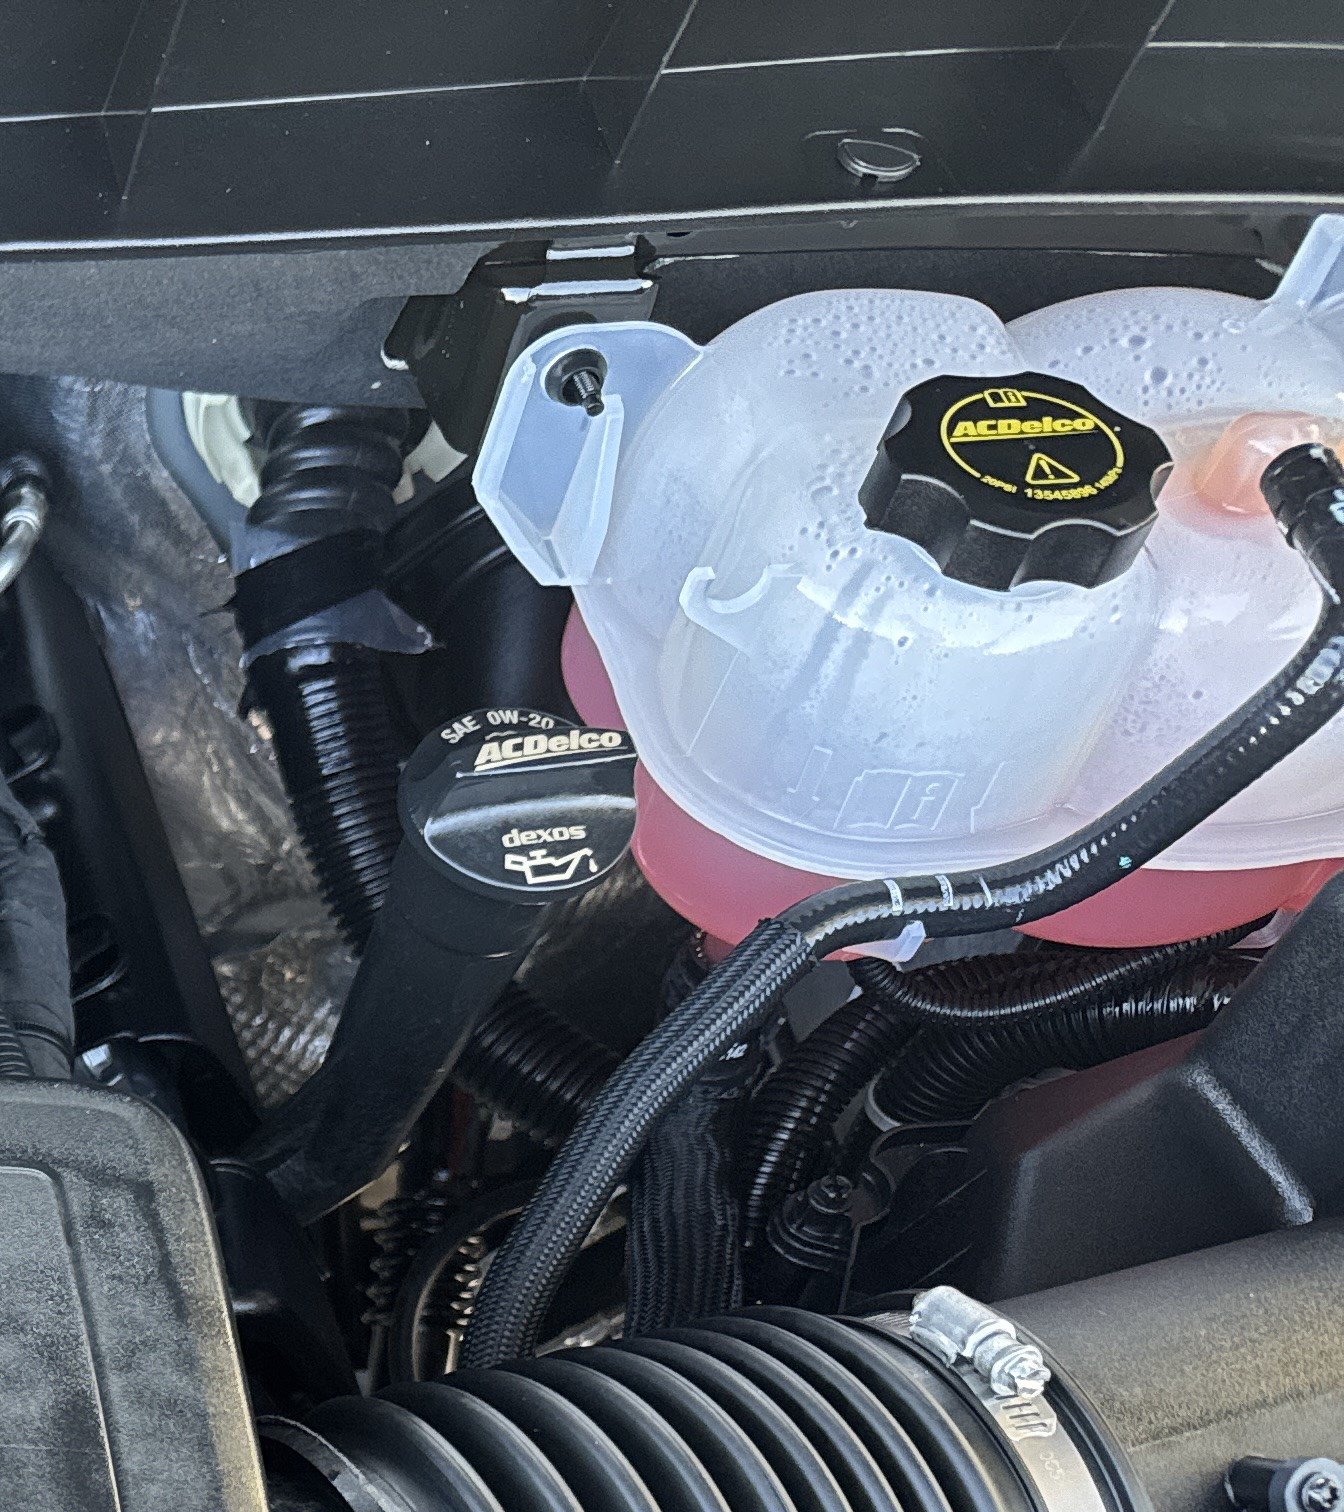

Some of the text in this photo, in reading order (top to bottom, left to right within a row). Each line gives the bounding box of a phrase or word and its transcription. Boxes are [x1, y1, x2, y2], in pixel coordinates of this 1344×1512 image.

[952, 417, 1096, 438] ACDelco
[440, 709, 555, 744] SAE 0W-20
[473, 729, 622, 766] ACDelco
[501, 825, 587, 848] dexos
